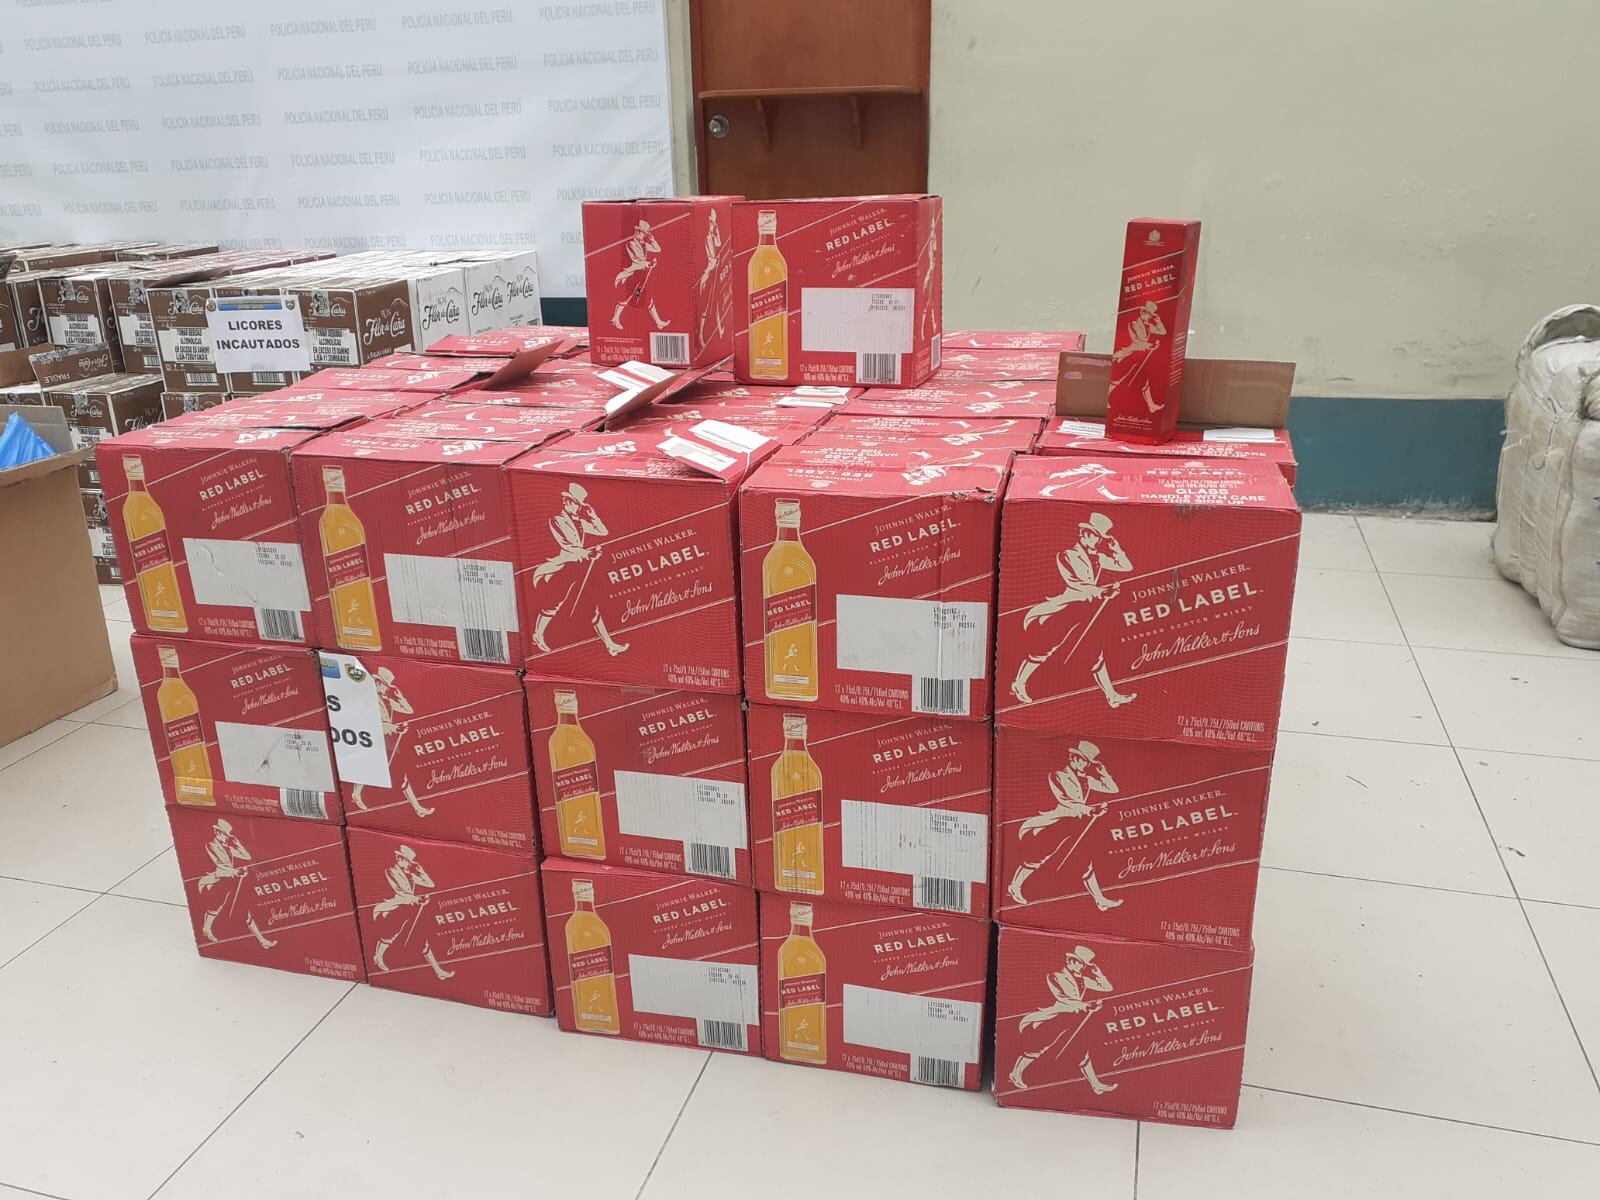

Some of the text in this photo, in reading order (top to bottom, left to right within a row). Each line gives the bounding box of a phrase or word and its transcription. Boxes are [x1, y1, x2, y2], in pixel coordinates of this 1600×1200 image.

[826, 220, 892, 250] RED LABEL
[1124, 274, 1175, 294] RED LABEL
[228, 320, 282, 330] LICORES
[217, 339, 299, 350] INCAUTADOS
[200, 469, 263, 500] RED LABEL
[405, 483, 478, 514] RED LABEL
[870, 521, 956, 552] RED LABEL
[875, 517, 913, 534] JOHNNIE
[611, 529, 695, 563] JOHNNIE WALKER
[608, 545, 704, 584] RED LABEL
[1132, 565, 1246, 602] JOHNNIE WALKER
[767, 600, 811, 616] RED LABEL
[1123, 582, 1257, 626] RED LABEL
[231, 664, 290, 689] RED LABEL
[639, 709, 713, 736] RED LABEL
[642, 698, 705, 721] JOHNNIE WALKER
[416, 712, 490, 738] JOHNNIE WALKER
[877, 725, 949, 748] JOHNNIE WALKER
[414, 726, 499, 755] RED LABEL
[872, 736, 958, 764] RED LABEL
[776, 802, 817, 817] RED LABEL
[1119, 790, 1223, 821] JOHNNIE WALKER
[1110, 805, 1232, 841] RED LABEL
[255, 871, 327, 896] RED LABEL
[438, 889, 507, 909] JOHNNIE WALKER
[653, 898, 726, 924] RED LABEL
[656, 888, 718, 910] JOHNNIE WALKER
[435, 902, 517, 925] RED LABEL
[874, 933, 954, 954] RED LABEL
[879, 922, 947, 939] JOHNNIE WALKER
[1113, 988, 1209, 1016] JOHNNIE WALKER
[1105, 1001, 1219, 1034] RED LABEL
